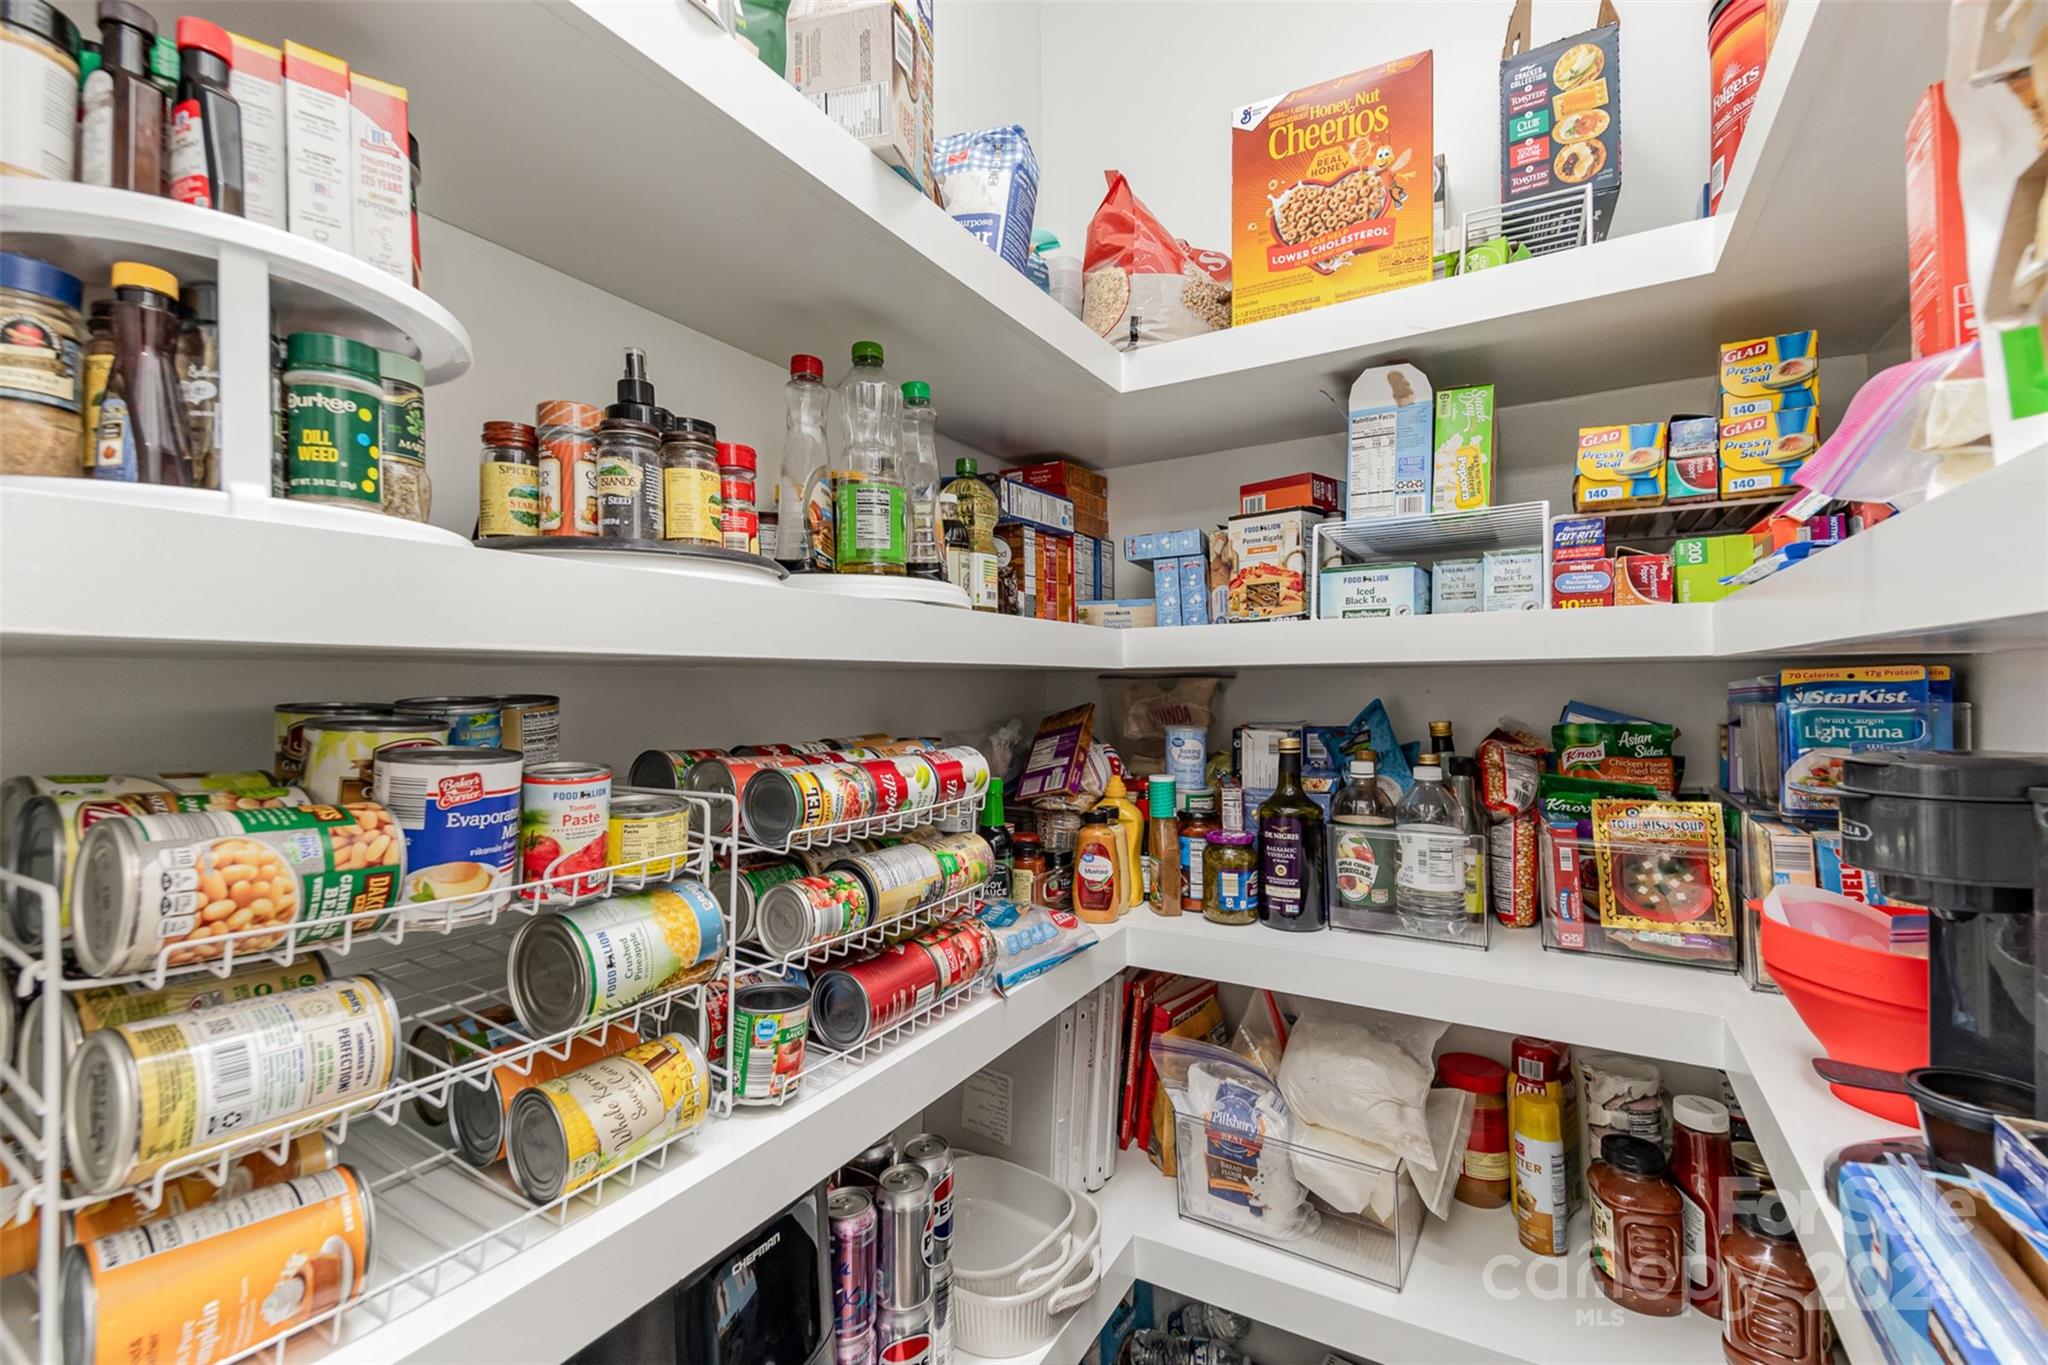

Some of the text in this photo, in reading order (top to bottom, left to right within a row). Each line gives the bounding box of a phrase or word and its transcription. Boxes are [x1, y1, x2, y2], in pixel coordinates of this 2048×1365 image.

[1514, 66, 1543, 81] CRACKER
[1511, 72, 1547, 89] COLLECTION
[1713, 65, 1759, 113] Folgers
[1310, 99, 1351, 121] Honey
[1355, 87, 1381, 107] Nut
[1517, 118, 1540, 132] CLUB
[1269, 105, 1389, 160] Cheerios
[361, 155, 403, 173] TRUSTED
[1317, 155, 1343, 168] REAL
[1311, 161, 1349, 178] HONEY
[378, 178, 403, 195] YEARS
[1272, 227, 1390, 266] LOWER CHOLESTEROL
[1309, 237, 1328, 248] CAN
[1724, 343, 1766, 363] GLAD
[1726, 363, 1773, 375] Press'n
[1741, 373, 1770, 385] Seal
[1733, 403, 1756, 415] 140
[1352, 413, 1395, 424] Nutrition Facts
[1722, 418, 1765, 437] GLAD
[302, 429, 333, 446] DILL
[1582, 430, 1620, 447] GLAD
[1725, 437, 1771, 450] Press'n
[297, 446, 340, 462] WEED
[1583, 449, 1624, 460] Press'n
[1740, 448, 1769, 459] Seal
[1595, 459, 1622, 469] Seal
[1457, 456, 1470, 501] Popcorn
[1732, 478, 1756, 490] 140
[1588, 488, 1608, 499] 140
[608, 496, 632, 505] SEED
[1688, 542, 1703, 564] 200
[1570, 562, 1595, 571] meijer
[1343, 574, 1389, 584] FOOD LION
[1494, 573, 1532, 582] Black Tea
[1640, 565, 1649, 584] Paper
[1650, 564, 1659, 600] Parchment
[1357, 587, 1375, 596] Iced
[1345, 595, 1387, 605] Black Tea
[1559, 599, 1580, 609] 10
[1803, 671, 1840, 679] Calories
[1864, 670, 1882, 678] 17g
[1884, 669, 1920, 677] Protein
[1809, 688, 1909, 705] StarKist
[1618, 731, 1653, 748] Asian
[1804, 725, 1904, 744] Light Tuna
[1566, 748, 1603, 764] Knorr
[1635, 745, 1665, 758] Sides
[1608, 759, 1644, 767] Chicken
[1626, 767, 1670, 775] Fried Rice
[441, 776, 481, 792] Baker's
[440, 790, 482, 808] Corner
[553, 788, 607, 801] FOOD LION
[569, 803, 597, 812] Tomato
[562, 812, 600, 827] Paste
[1611, 819, 1704, 831] TOFU MISO SOUP
[1274, 832, 1299, 840] NIGRIS
[1266, 845, 1297, 854] BALSAMIC
[1267, 851, 1296, 860] VINEGAR
[619, 937, 633, 979] Crushed
[630, 931, 643, 981] Pineapple
[596, 931, 617, 999] FOOD LION
[337, 1028, 353, 1094] PERFECTION!
[619, 1083, 648, 1121] Sweet
[603, 1100, 633, 1152] Whole
[1213, 1109, 1257, 1137] Pillsbury
[1221, 1132, 1243, 1145] BEST
[1220, 1161, 1242, 1172] BREAD
[1221, 1169, 1242, 1179] FLOUR
